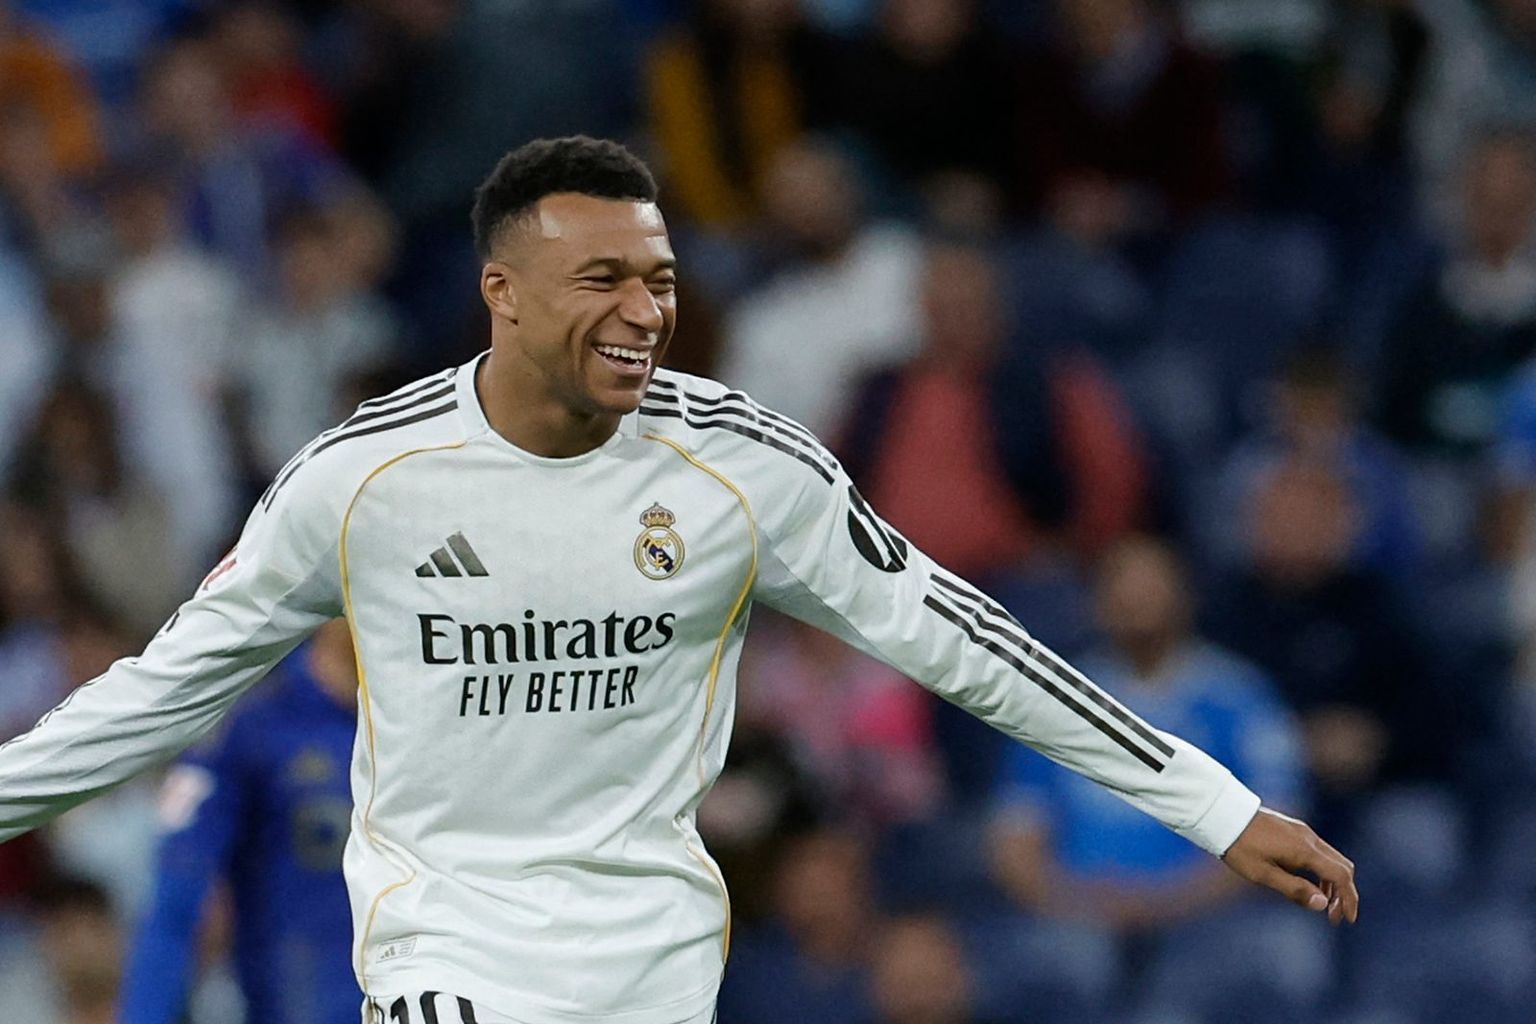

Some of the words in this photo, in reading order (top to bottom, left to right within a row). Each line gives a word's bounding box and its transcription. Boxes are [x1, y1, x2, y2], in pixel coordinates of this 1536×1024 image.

[416, 609, 676, 665] Emirates
[459, 673, 514, 717] FLY
[525, 666, 639, 714] BETTER
